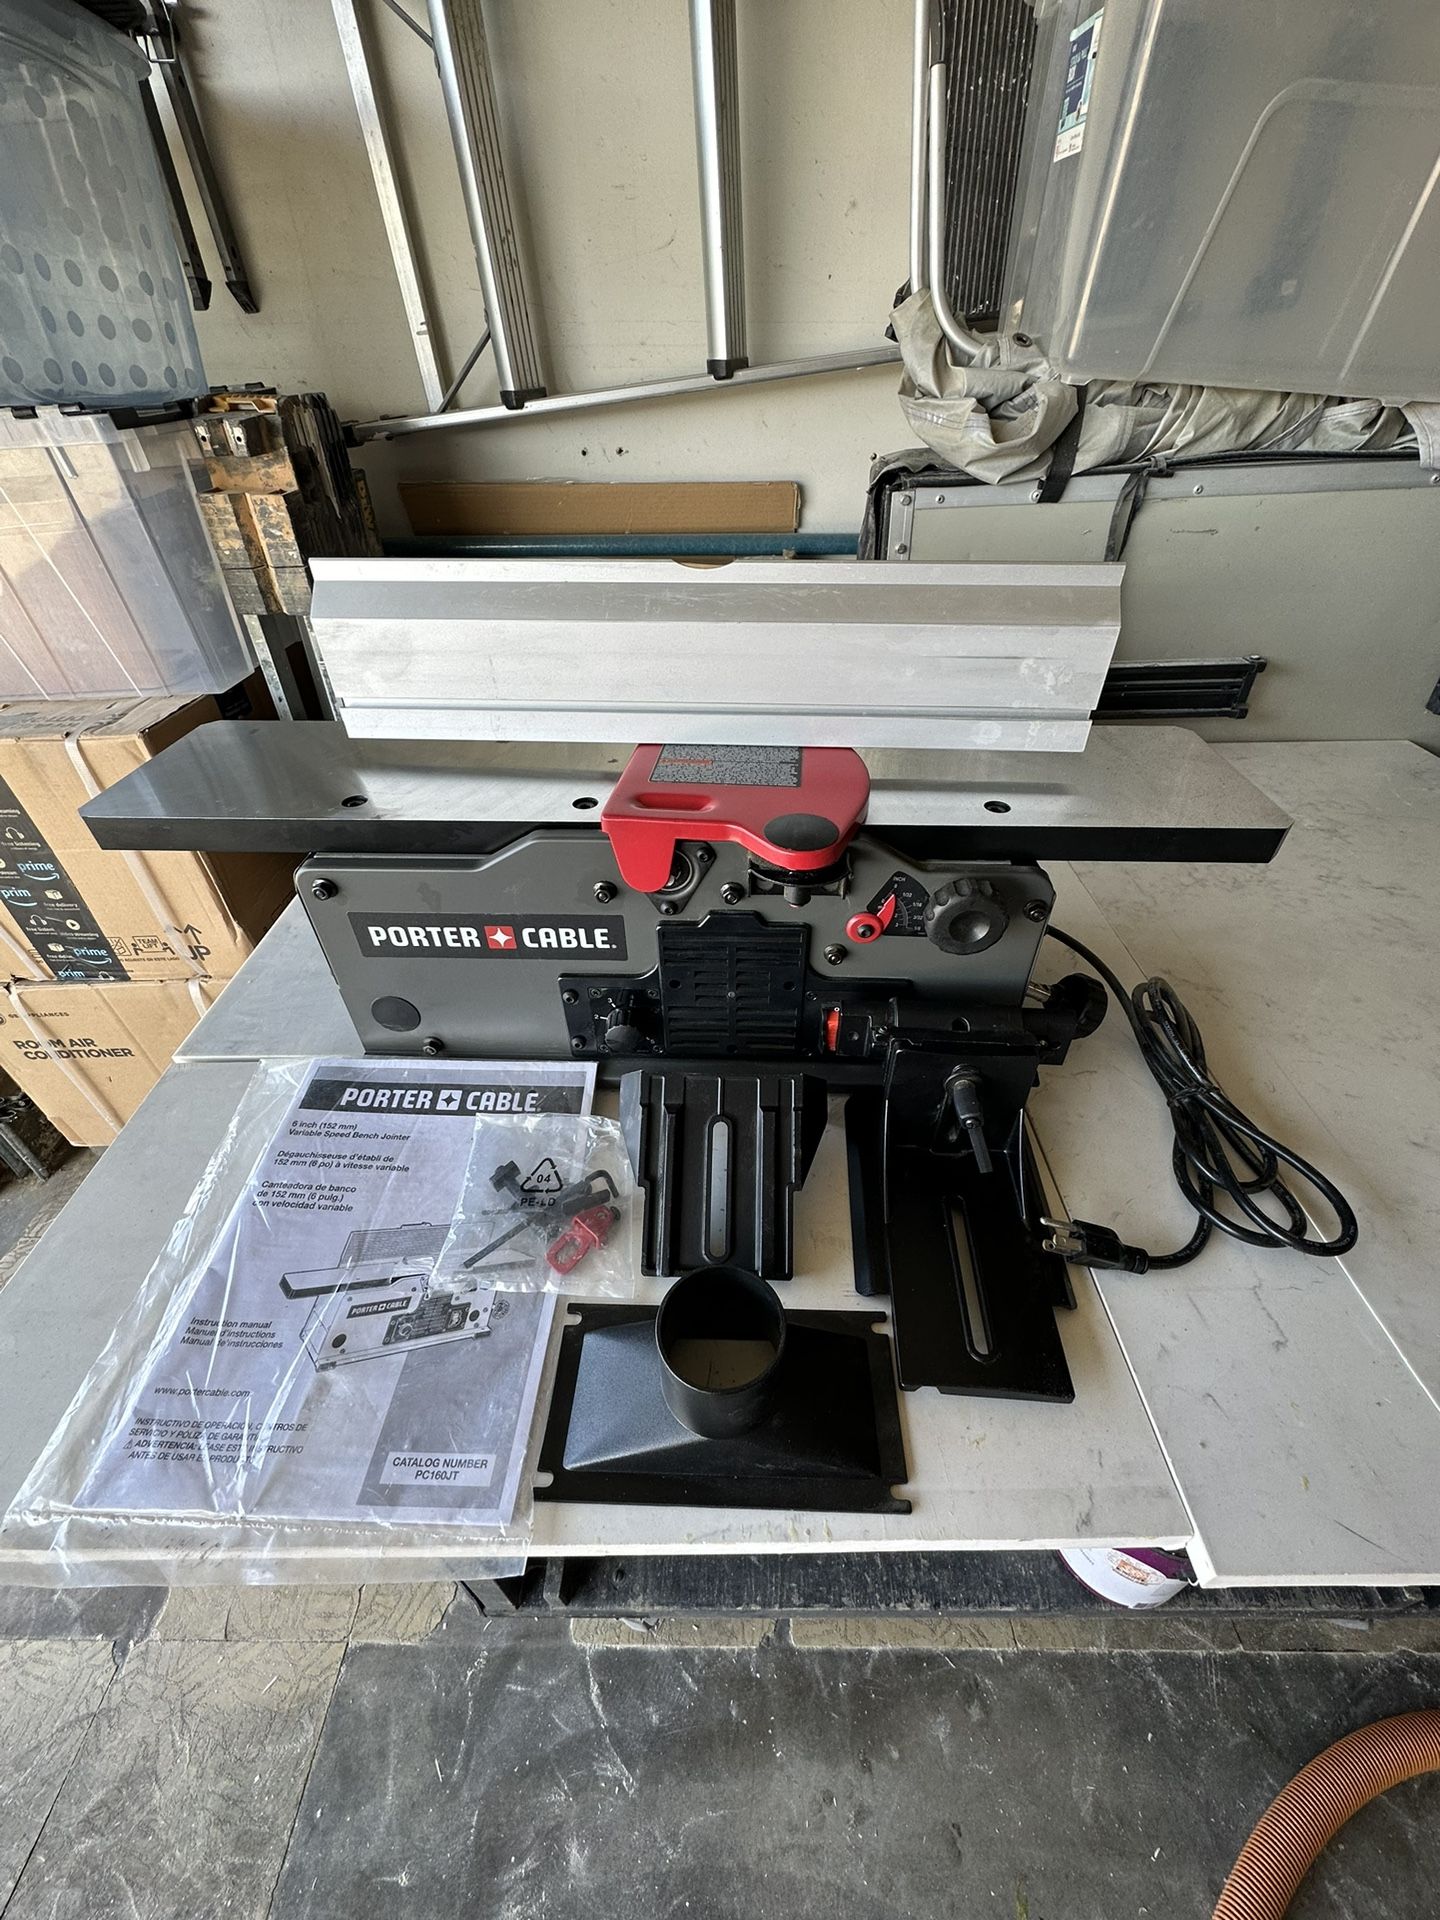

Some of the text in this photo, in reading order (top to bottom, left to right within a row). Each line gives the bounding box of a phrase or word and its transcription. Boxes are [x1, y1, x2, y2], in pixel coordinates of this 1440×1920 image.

[17, 860, 55, 872] prime
[367, 926, 482, 949] PORTER
[73, 946, 109, 957] prime
[68, 1038, 98, 1048] AIR
[340, 1087, 434, 1109] PORTER
[291, 1120, 358, 1131] 6 inch (152 mm)
[288, 1128, 411, 1141] Variable Speed Bench Jointer
[276, 1150, 348, 1161] Dégauchisseuse
[382, 1155, 395, 1163] de
[273, 1158, 290, 1166] 152
[308, 1159, 318, 1168] (6
[317, 1160, 334, 1170] po)
[334, 1161, 342, 1169] à
[342, 1162, 374, 1170] vitesse
[374, 1163, 410, 1173] variable
[536, 1173, 551, 1183] 04
[260, 1180, 313, 1191] Canteadora
[327, 1184, 357, 1193] banco
[256, 1189, 345, 1203] de 152 mm (6 pulg.)
[520, 1197, 556, 1207] PE-LD
[270, 1199, 316, 1210] velocidad
[317, 1202, 354, 1212] variable
[351, 1300, 408, 1315] PORTER CABLE
[239, 1320, 272, 1329] manual
[179, 1335, 214, 1346] Manual
[134, 1417, 191, 1428] INSTRUCTIVO
[190, 1420, 203, 1428] DE
[295, 1423, 308, 1432] DE
[169, 1430, 177, 1438] Y
[206, 1432, 221, 1441] DE
[134, 1439, 198, 1450] ADVERTENCIA:
[127, 1450, 157, 1460] ANTES
[157, 1451, 171, 1461] DE
[170, 1452, 196, 1461] USAR
[391, 1456, 489, 1469] CATALOG NUMBER
[414, 1469, 460, 1481] PC160JT
